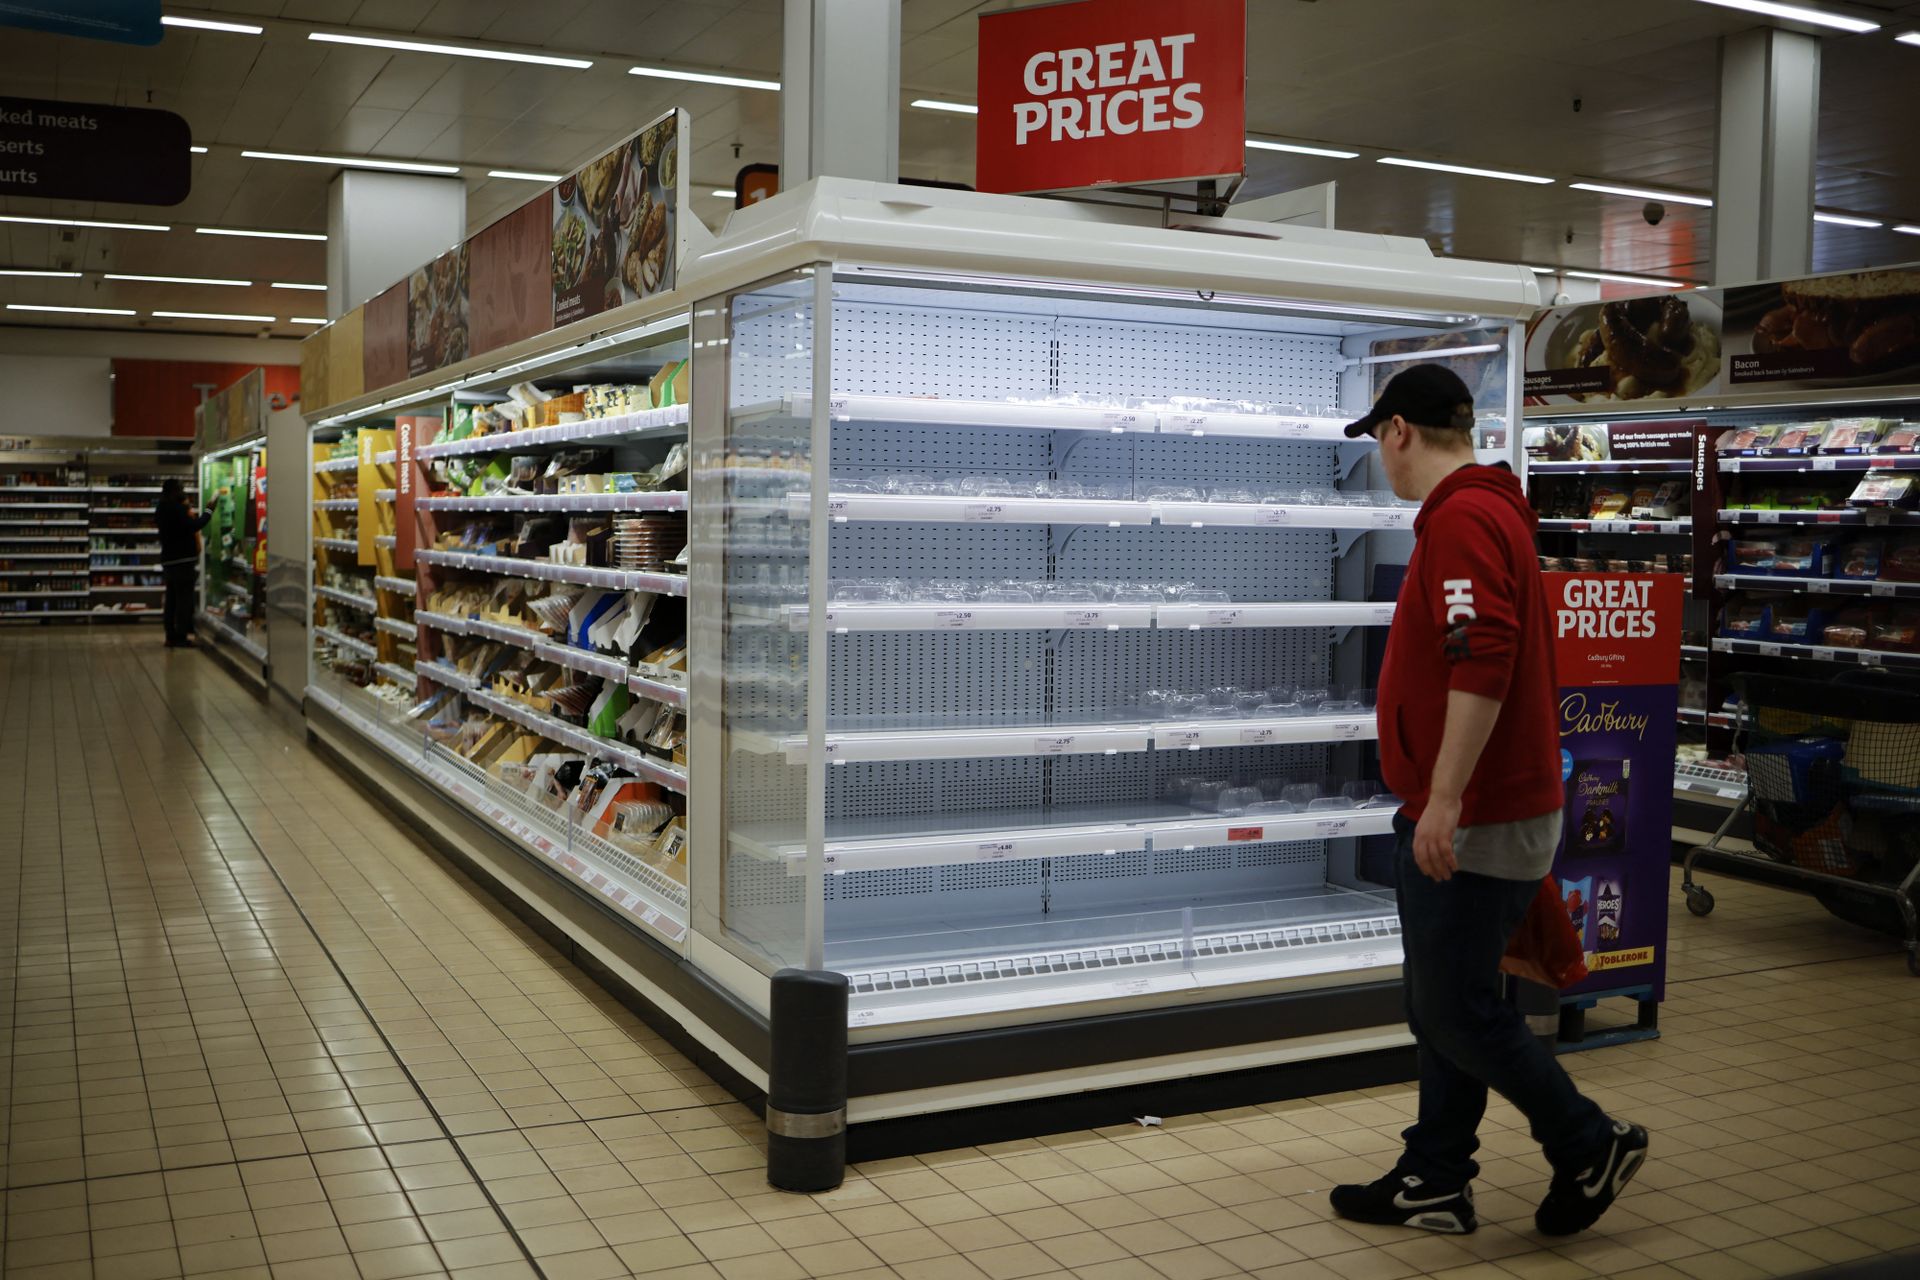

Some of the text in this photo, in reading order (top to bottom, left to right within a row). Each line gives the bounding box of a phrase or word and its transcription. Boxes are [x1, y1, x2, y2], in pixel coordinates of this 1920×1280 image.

[1023, 33, 1195, 96] GREAT
[38, 113, 98, 130] meats
[1013, 82, 1204, 145] PRICES
[1734, 360, 1760, 369] Bacon
[1647, 433, 1669, 441] sausages
[401, 423, 411, 494] Cooked meats
[1695, 434, 1707, 491] Sausages
[1563, 579, 1654, 608] GREAT
[1556, 609, 1656, 638] PRICES
[1587, 653, 1625, 663] Cadbury Gifting
[1559, 692, 1649, 741] Cadbury
[1578, 772, 1600, 783] Cadbury
[1578, 781, 1618, 796] Darkmilk
[1597, 898, 1620, 911] HEROES
[1600, 951, 1648, 966] TOBLERONE
